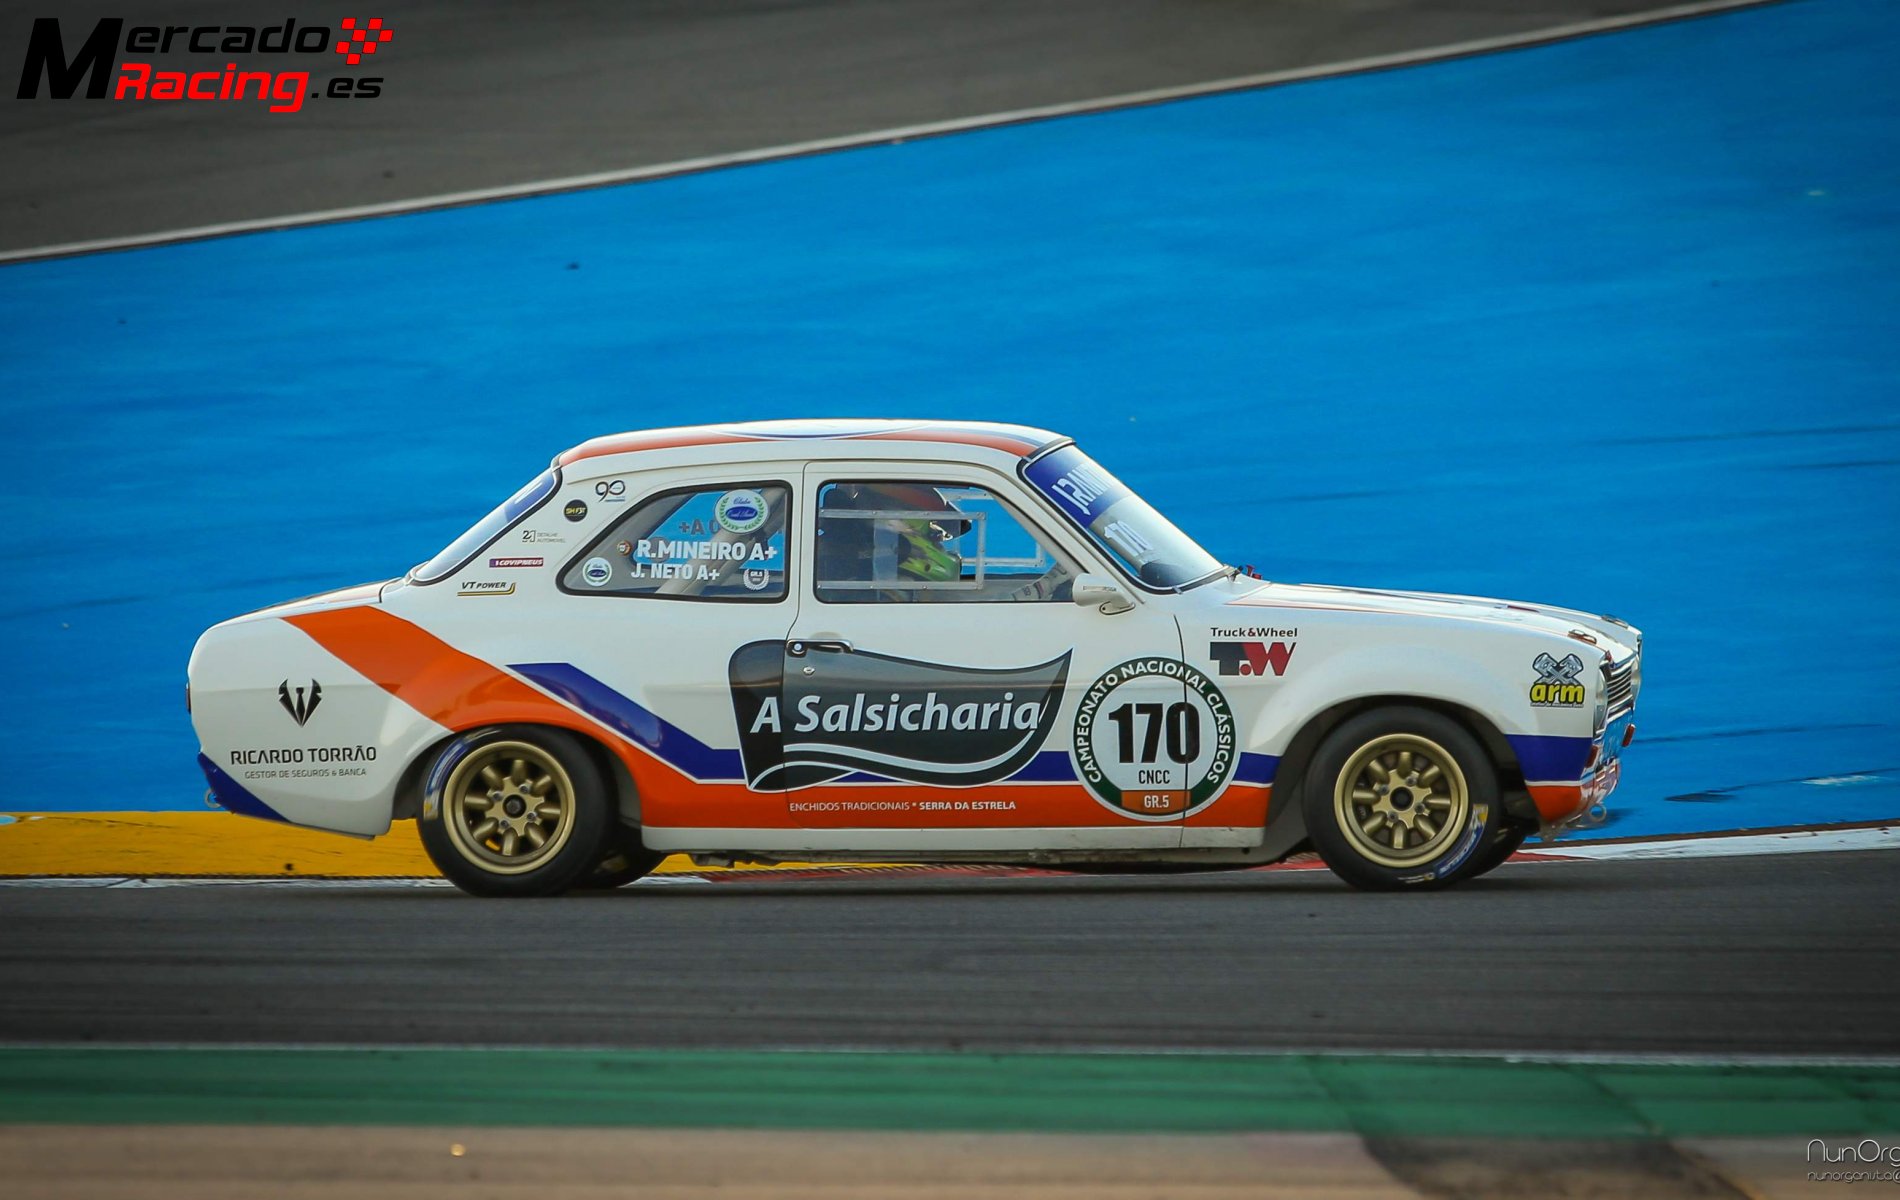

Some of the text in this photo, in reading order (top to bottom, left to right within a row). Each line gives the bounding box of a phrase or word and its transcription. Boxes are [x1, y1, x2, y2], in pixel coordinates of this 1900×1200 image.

[636, 539, 746, 561] R.MINEIRO
[749, 542, 778, 562] A+
[630, 563, 720, 581] J. NETO A+
[462, 581, 507, 589] VT POWER
[1210, 627, 1298, 637] Truck&Wheel
[1530, 682, 1585, 704] arm
[750, 691, 1041, 733] A Salsicharia
[1076, 660, 1232, 784] CAMPEONATO NACIONAL CLÁSSICOS
[1108, 701, 1200, 764] 170
[231, 745, 377, 766] RICARDO TORRÃO
[244, 770, 278, 779] GESTOR
[278, 770, 290, 779] DE
[291, 769, 330, 778] SEGUROS
[338, 768, 366, 777] BANCA
[1138, 769, 1171, 784] CNCC
[789, 801, 1016, 811] ENCHIDOS TRADICIONAIS SERRA DA ESTRELA
[1144, 794, 1169, 808] GR.5
